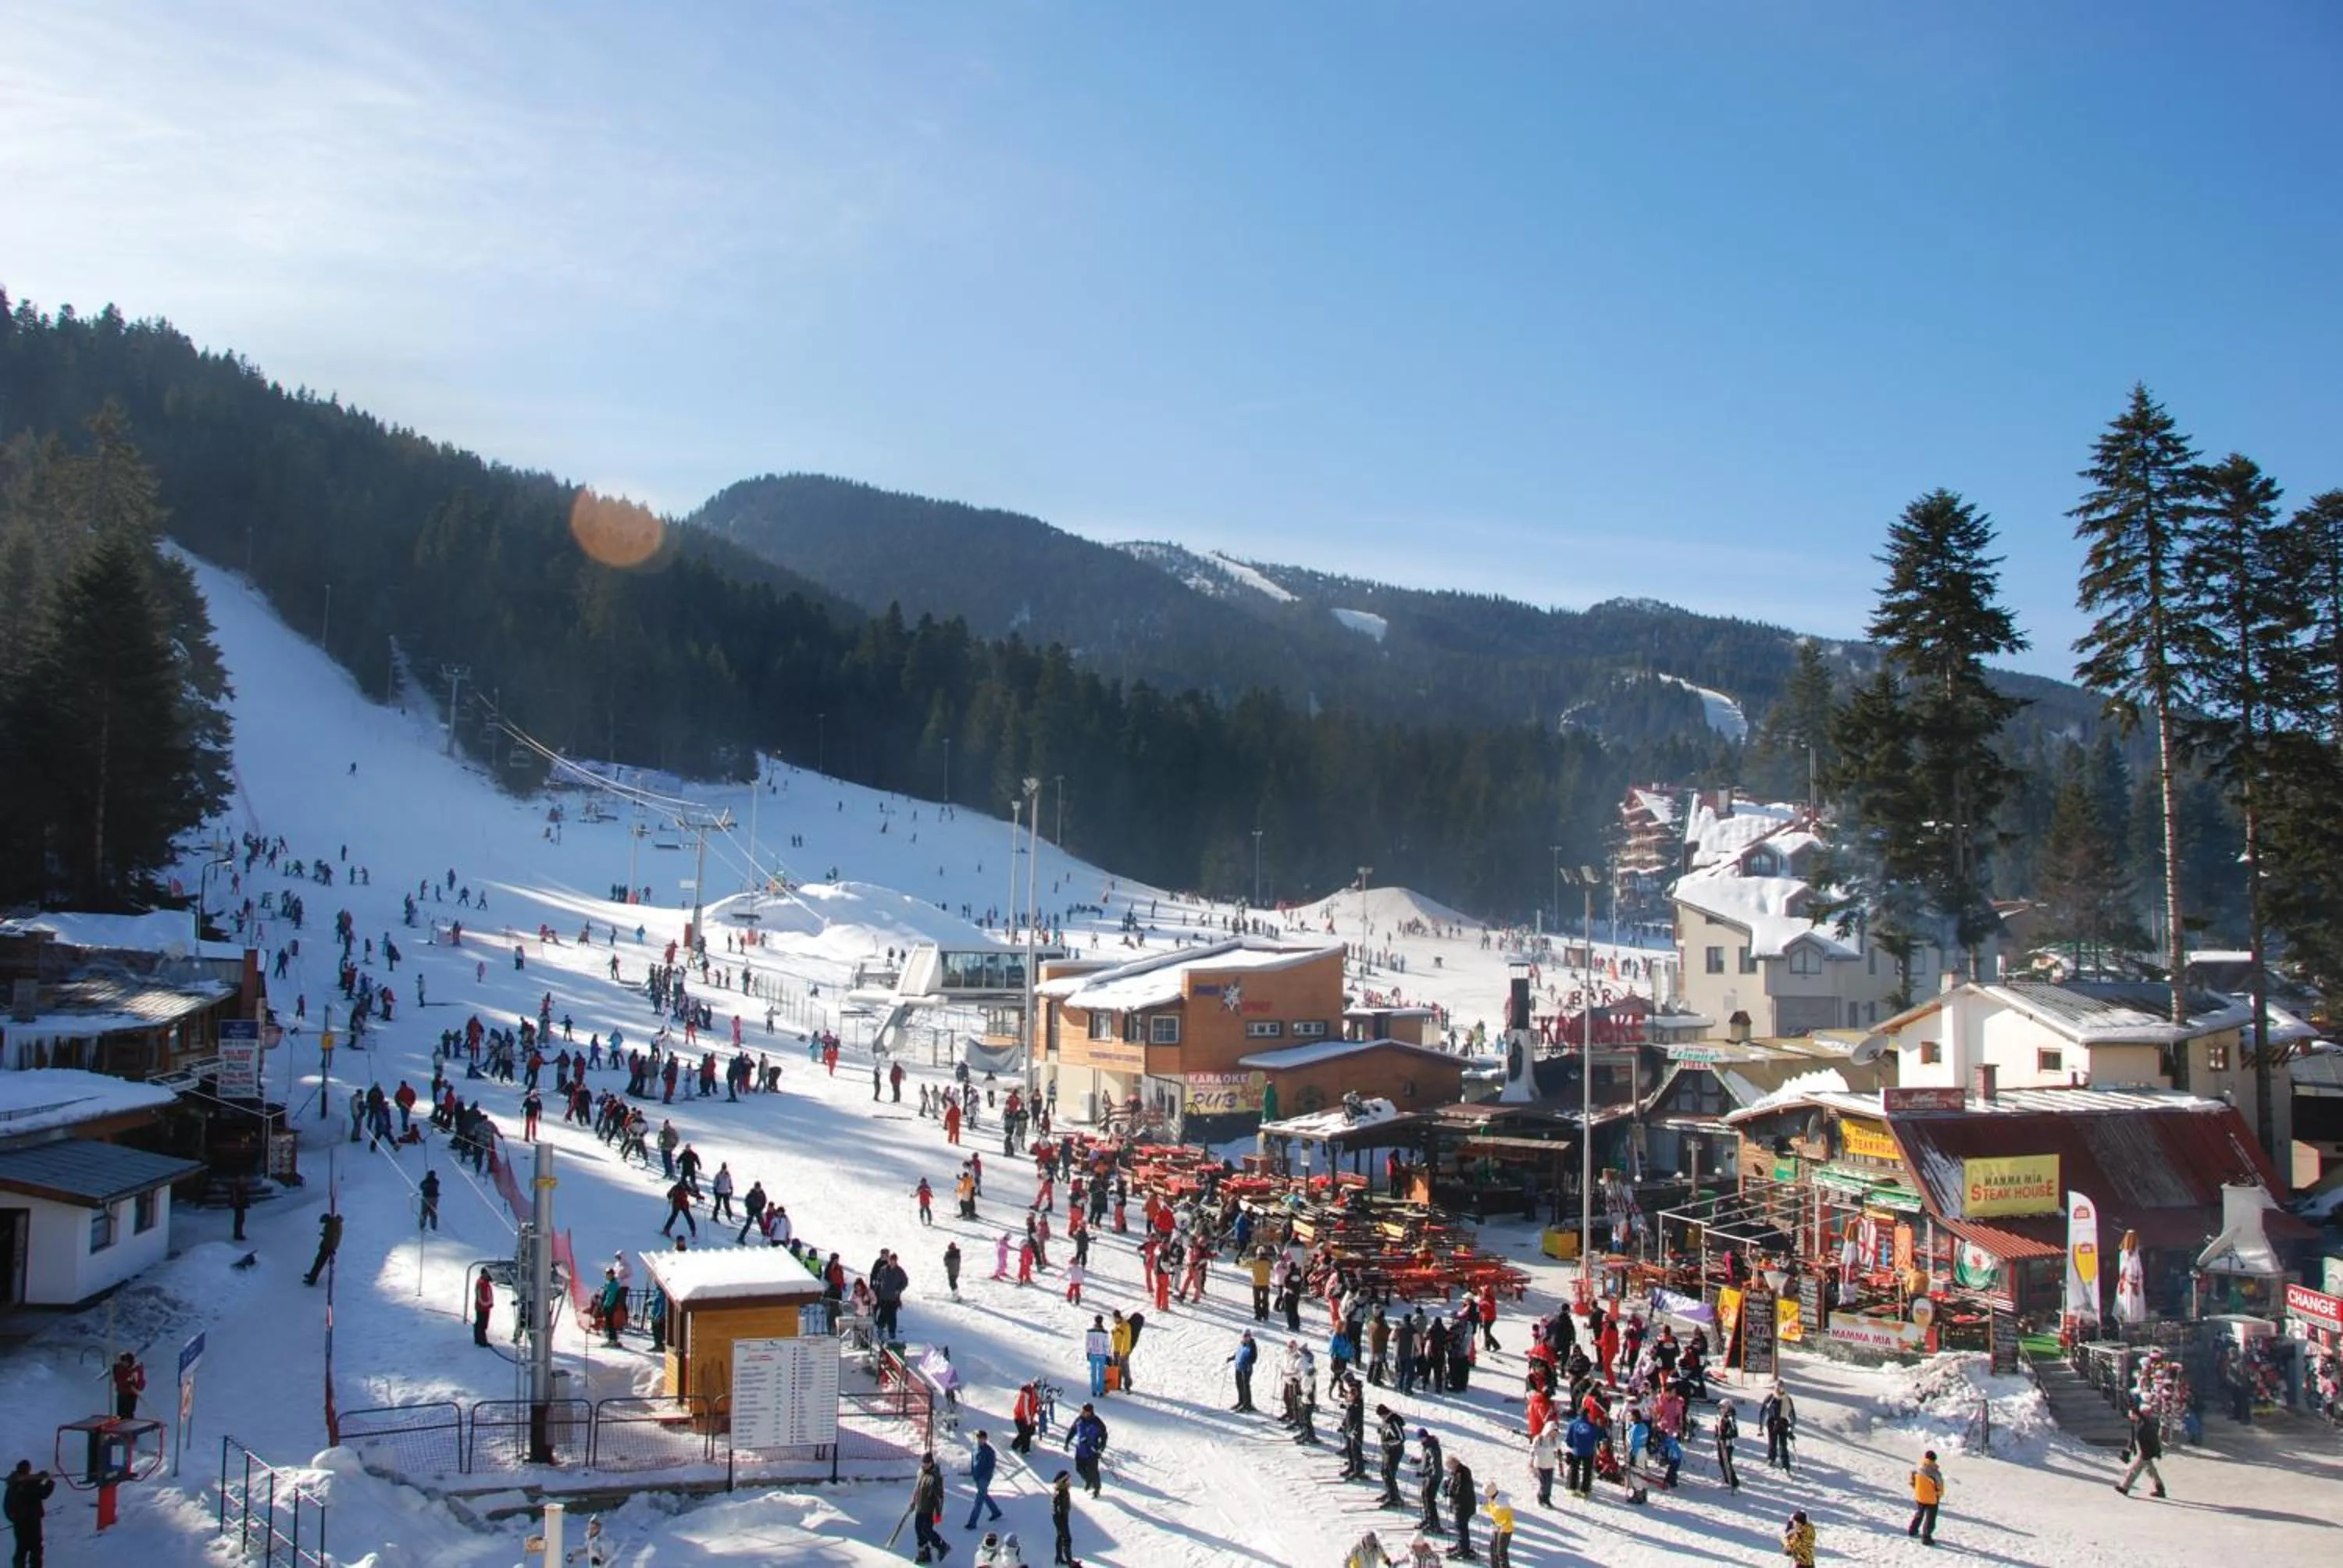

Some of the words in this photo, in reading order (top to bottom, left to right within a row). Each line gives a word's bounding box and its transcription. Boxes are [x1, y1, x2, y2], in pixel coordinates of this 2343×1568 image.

[1188, 1074, 1248, 1084] KARAOKE
[1194, 1092, 1237, 1107] PUB
[1984, 1175, 2021, 1185] MAMMA
[1971, 1183, 2013, 1201] STEAK
[2015, 1179, 2054, 1199] HOUSE
[2288, 1289, 2337, 1317] CHANGE
[1831, 1328, 1870, 1342] MAMMA
[1873, 1334, 1892, 1345] MIA
